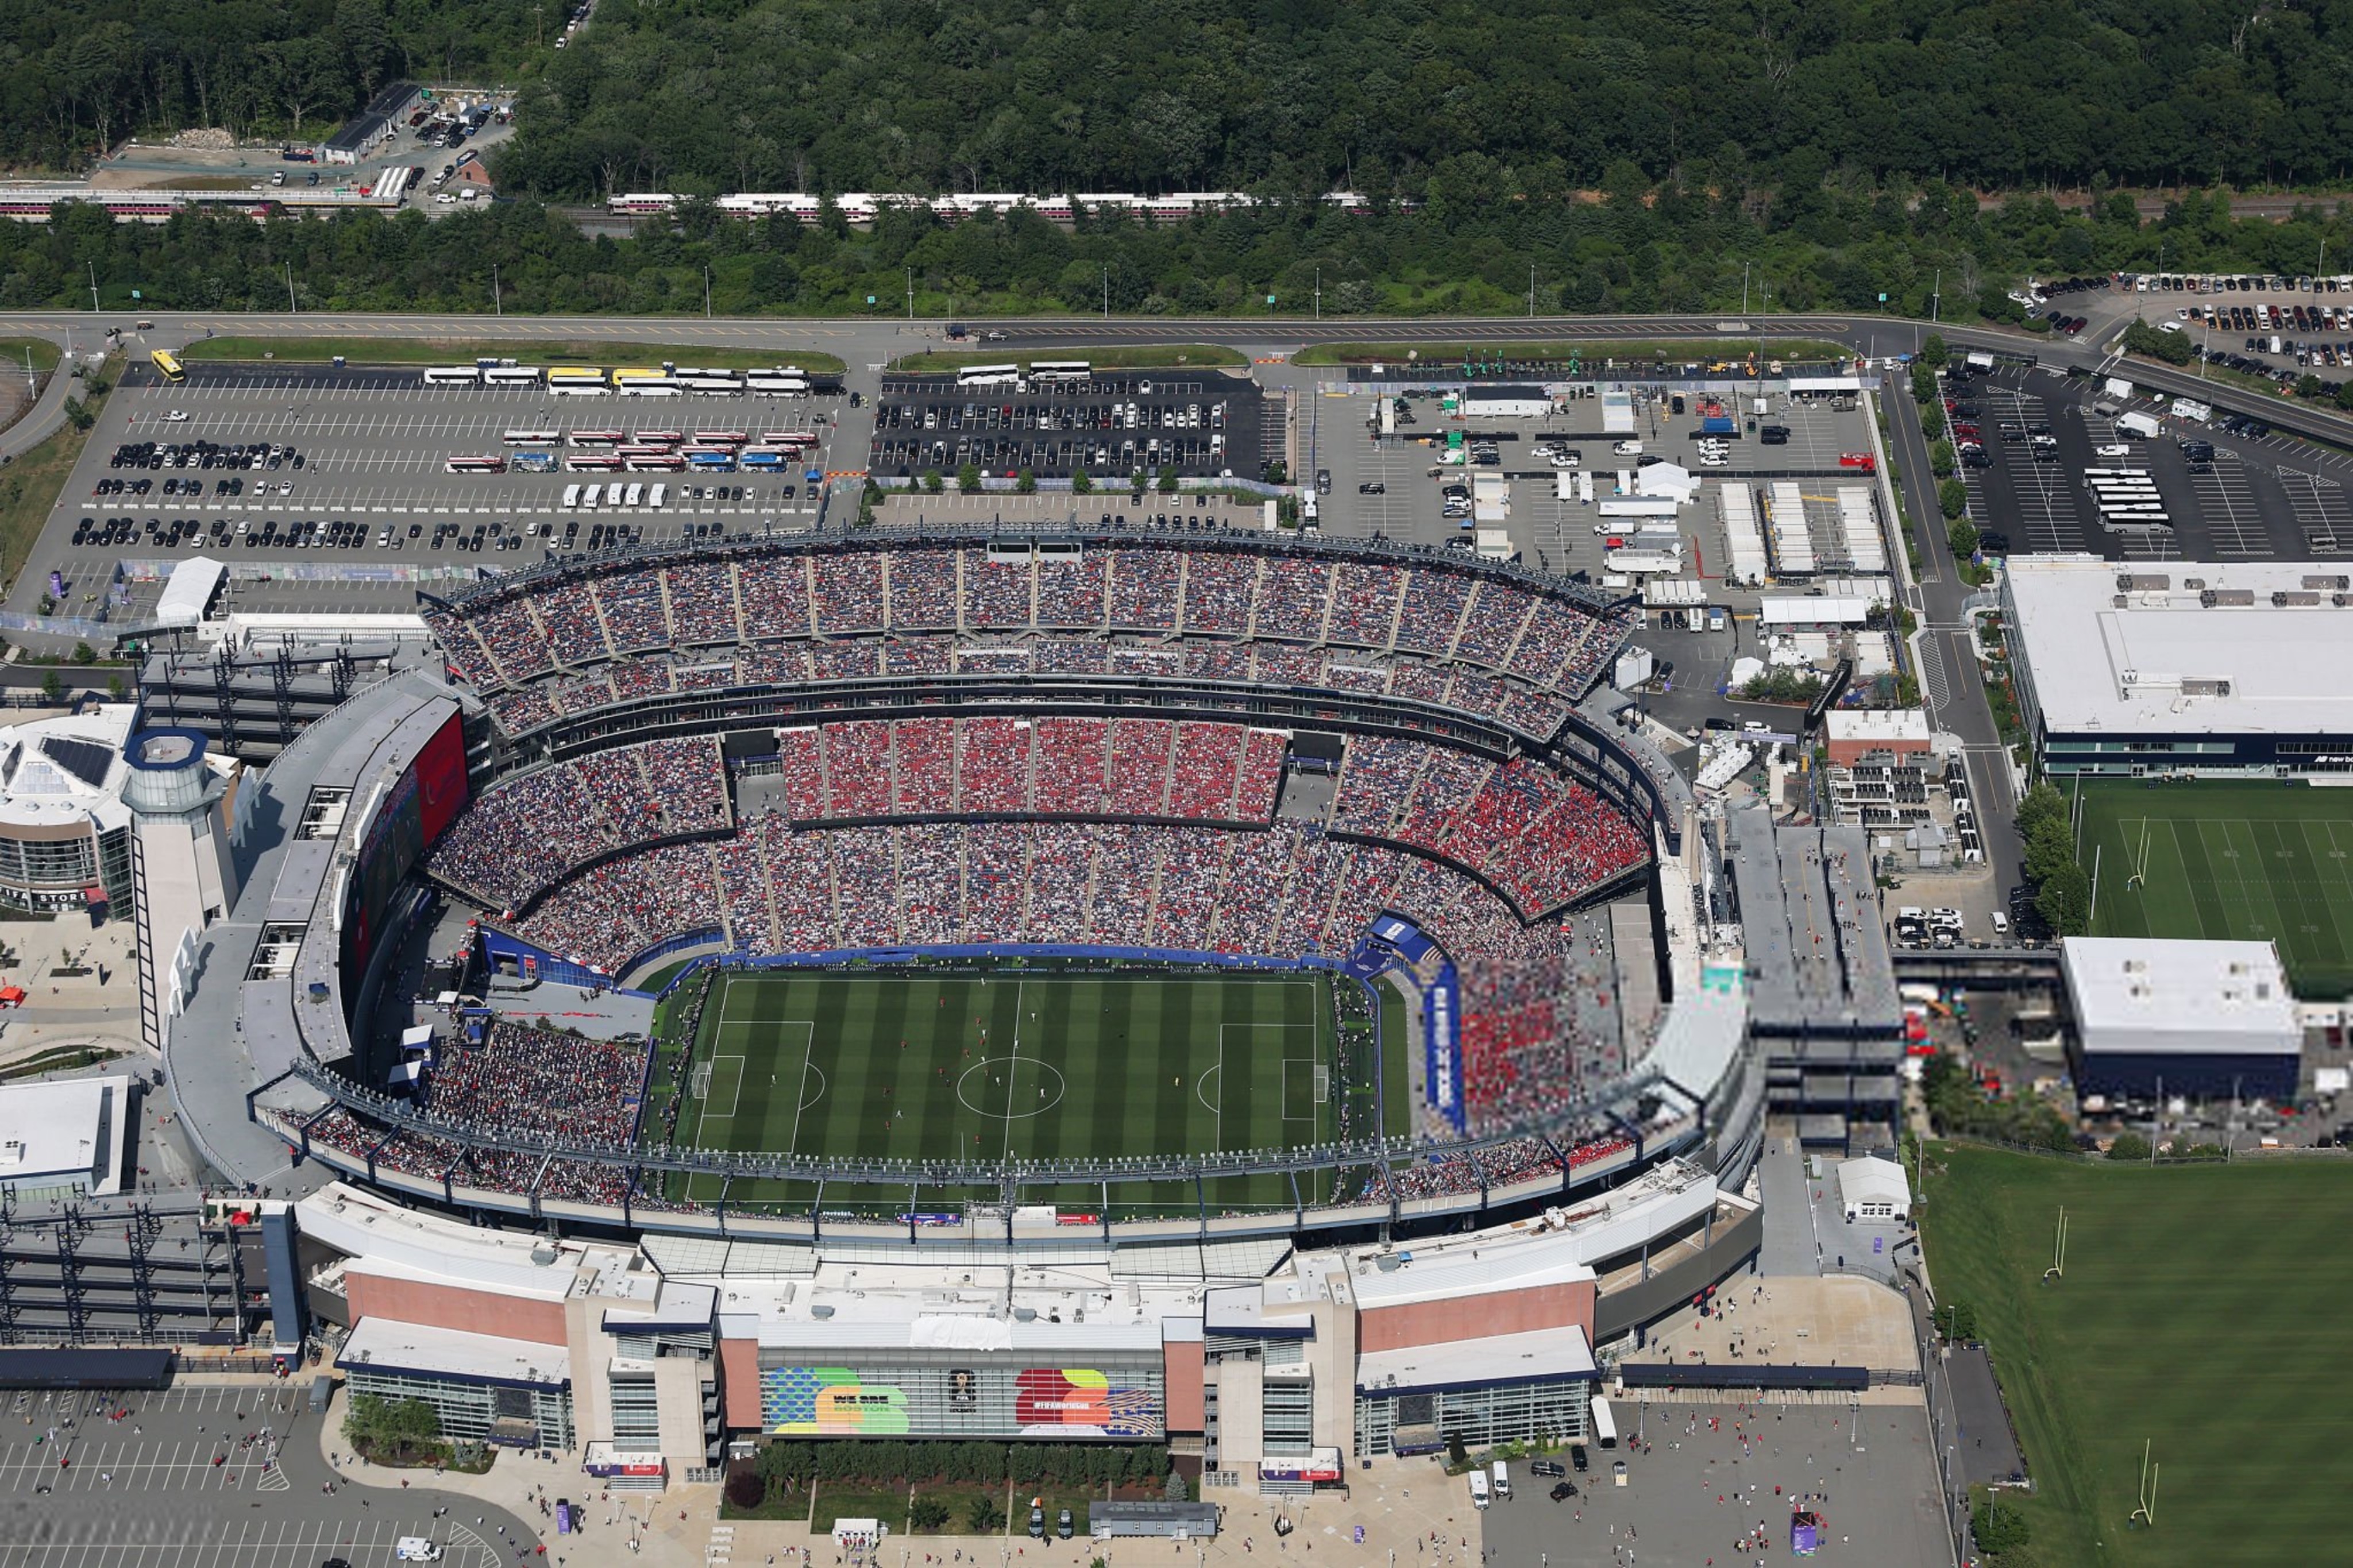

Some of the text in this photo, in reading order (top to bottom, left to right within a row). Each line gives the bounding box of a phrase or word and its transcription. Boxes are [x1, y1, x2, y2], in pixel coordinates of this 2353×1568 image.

[40, 893, 86, 902] STORE
[834, 1396, 889, 1404] WE ARE
